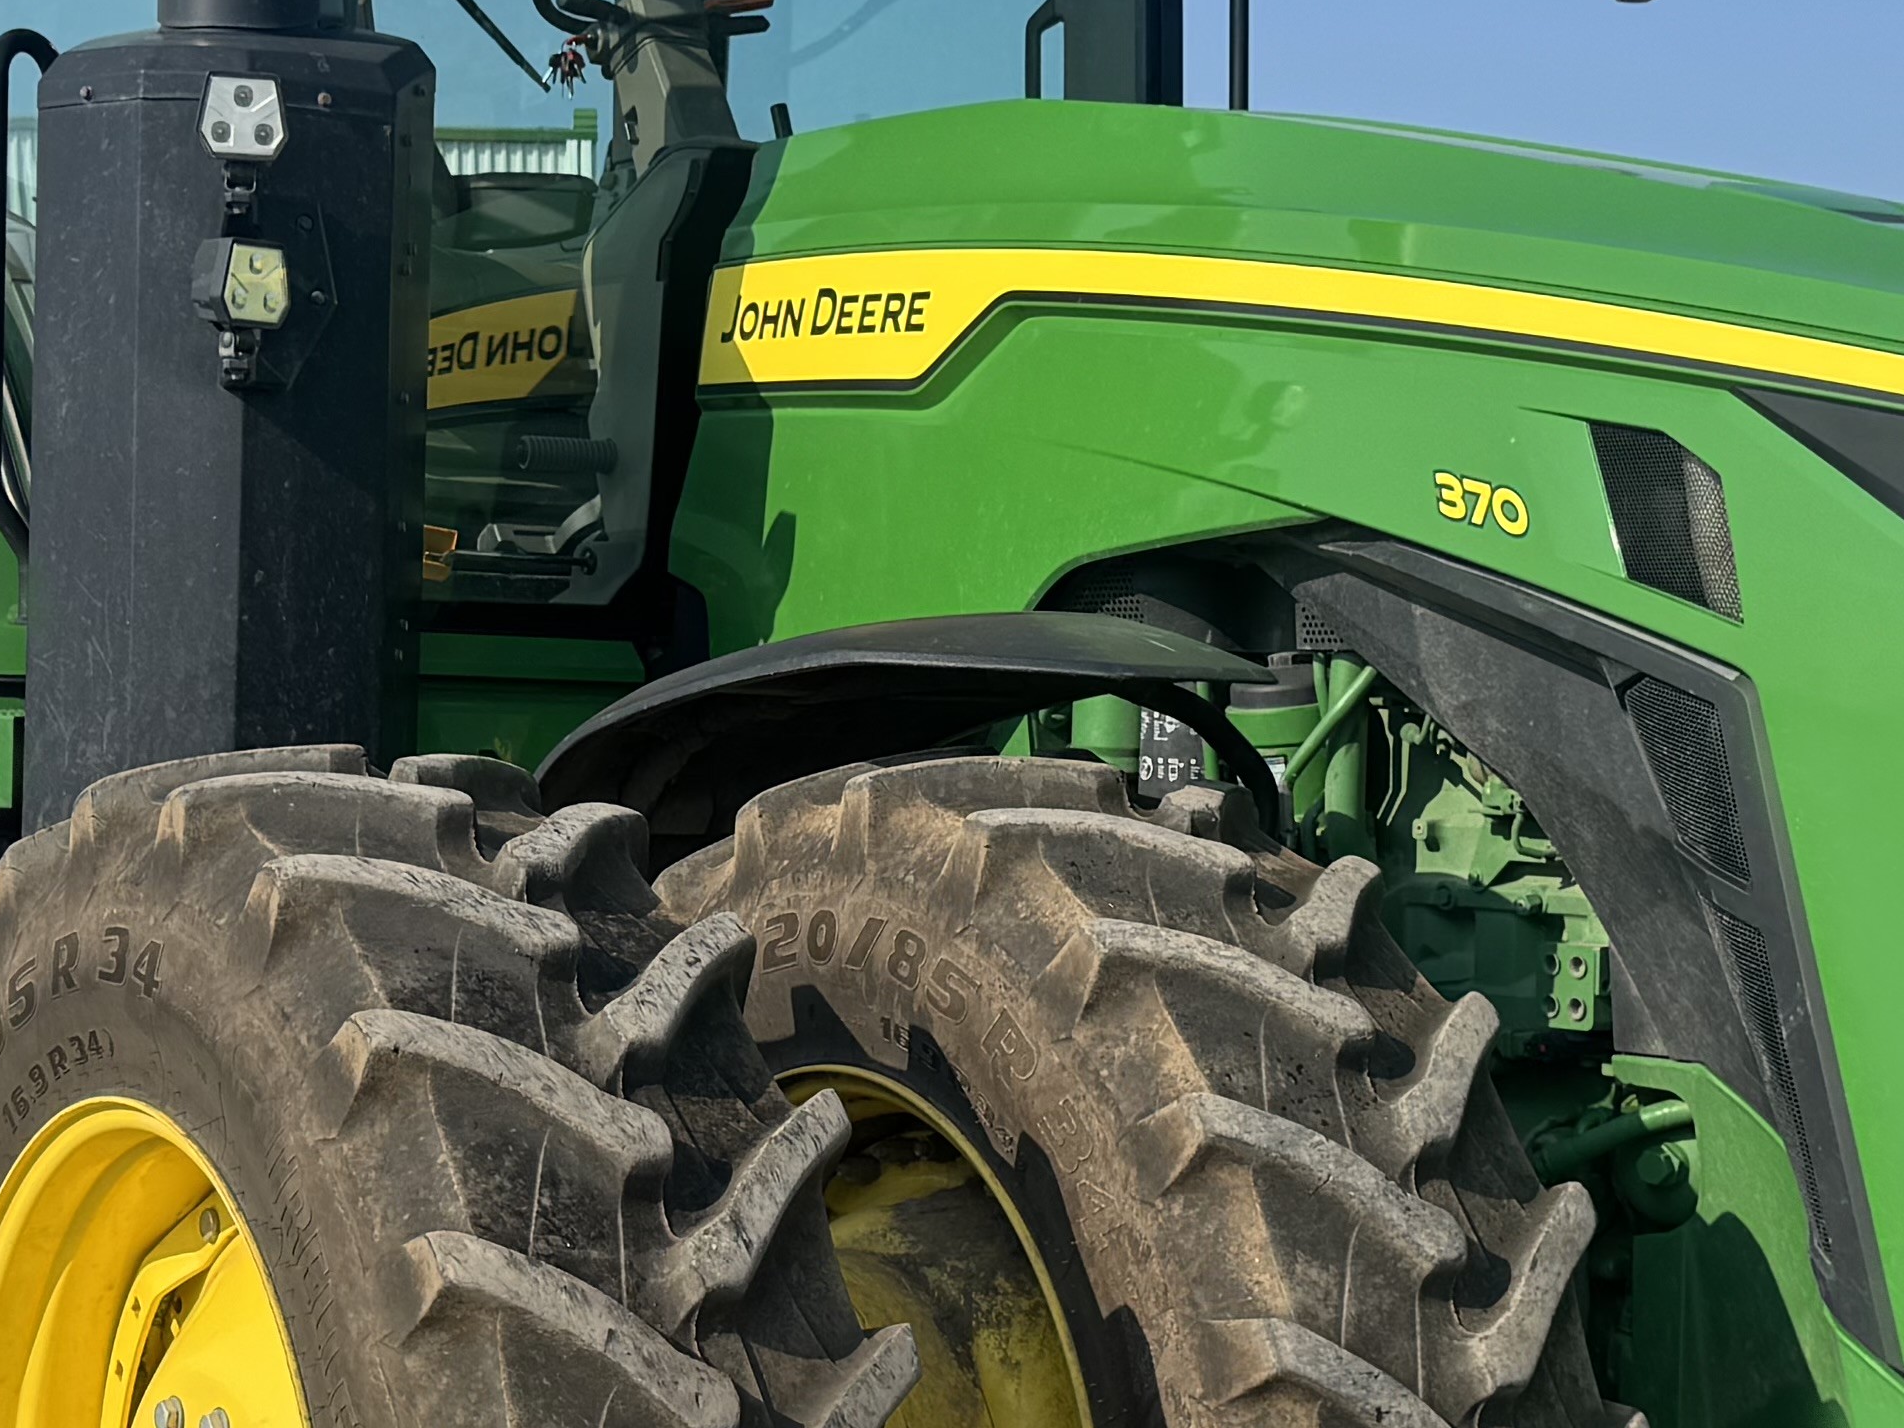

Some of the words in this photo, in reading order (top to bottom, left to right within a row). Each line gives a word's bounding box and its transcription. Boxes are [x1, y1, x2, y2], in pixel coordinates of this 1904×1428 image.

[721, 294, 806, 344] JOHN
[810, 287, 931, 336] DEERE
[1433, 470, 1530, 537] 370
[50, 930, 82, 1000] R
[97, 925, 166, 1000] 34
[762, 909, 982, 1024] 20/85
